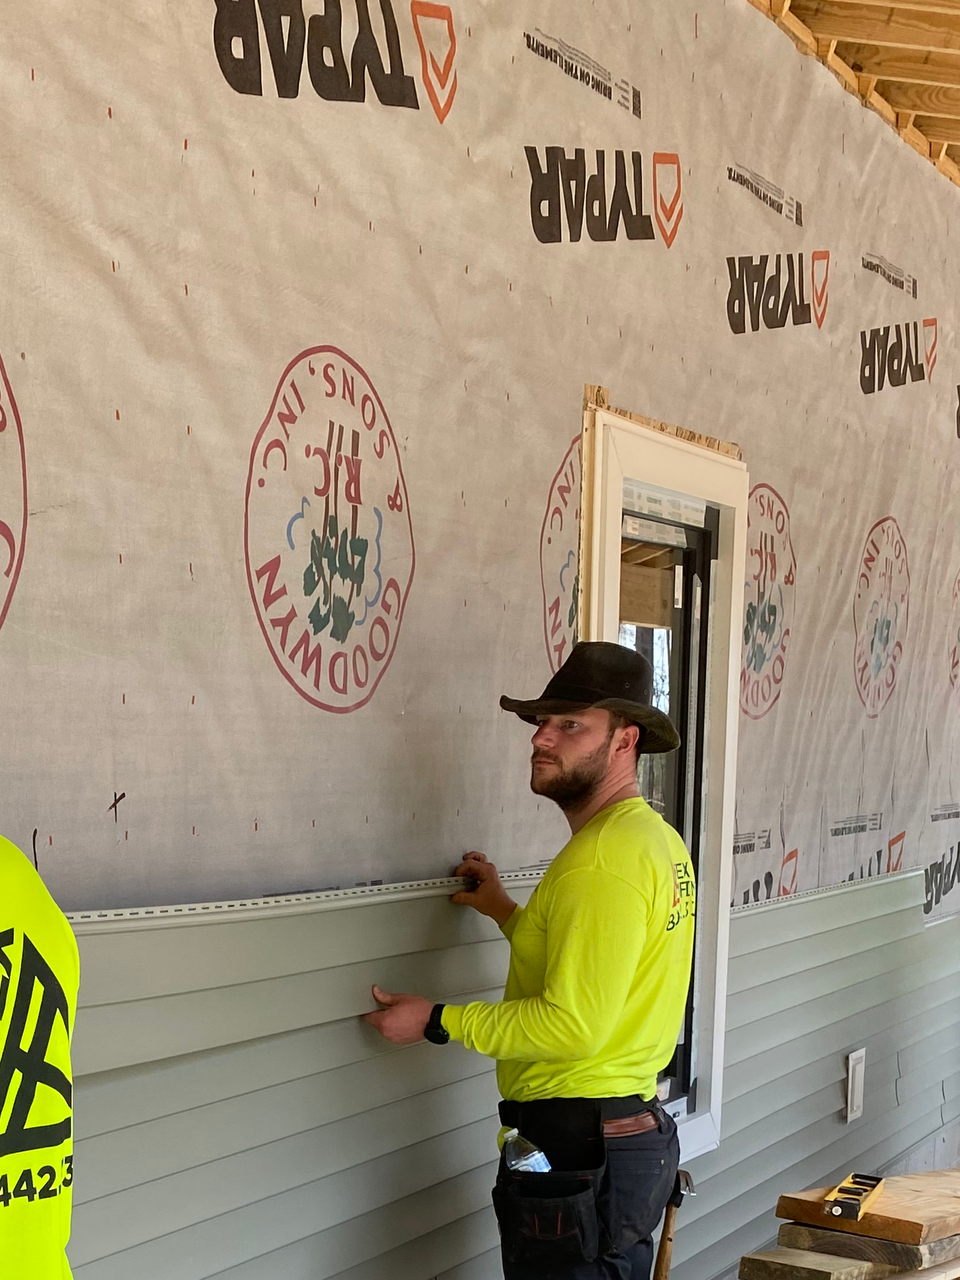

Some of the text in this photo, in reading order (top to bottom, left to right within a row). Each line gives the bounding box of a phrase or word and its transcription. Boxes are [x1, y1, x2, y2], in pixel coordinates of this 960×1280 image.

[213, 0, 420, 110] TYPAR
[524, 146, 655, 244] TYPAR
[726, 252, 812, 335] TYPAR
[860, 318, 926, 394] TYPAR
[256, 379, 307, 488] INC.
[304, 443, 363, 506] R.C.
[386, 475, 403, 513] &
[857, 537, 881, 600] INC.
[254, 553, 402, 696] GOODWYN
